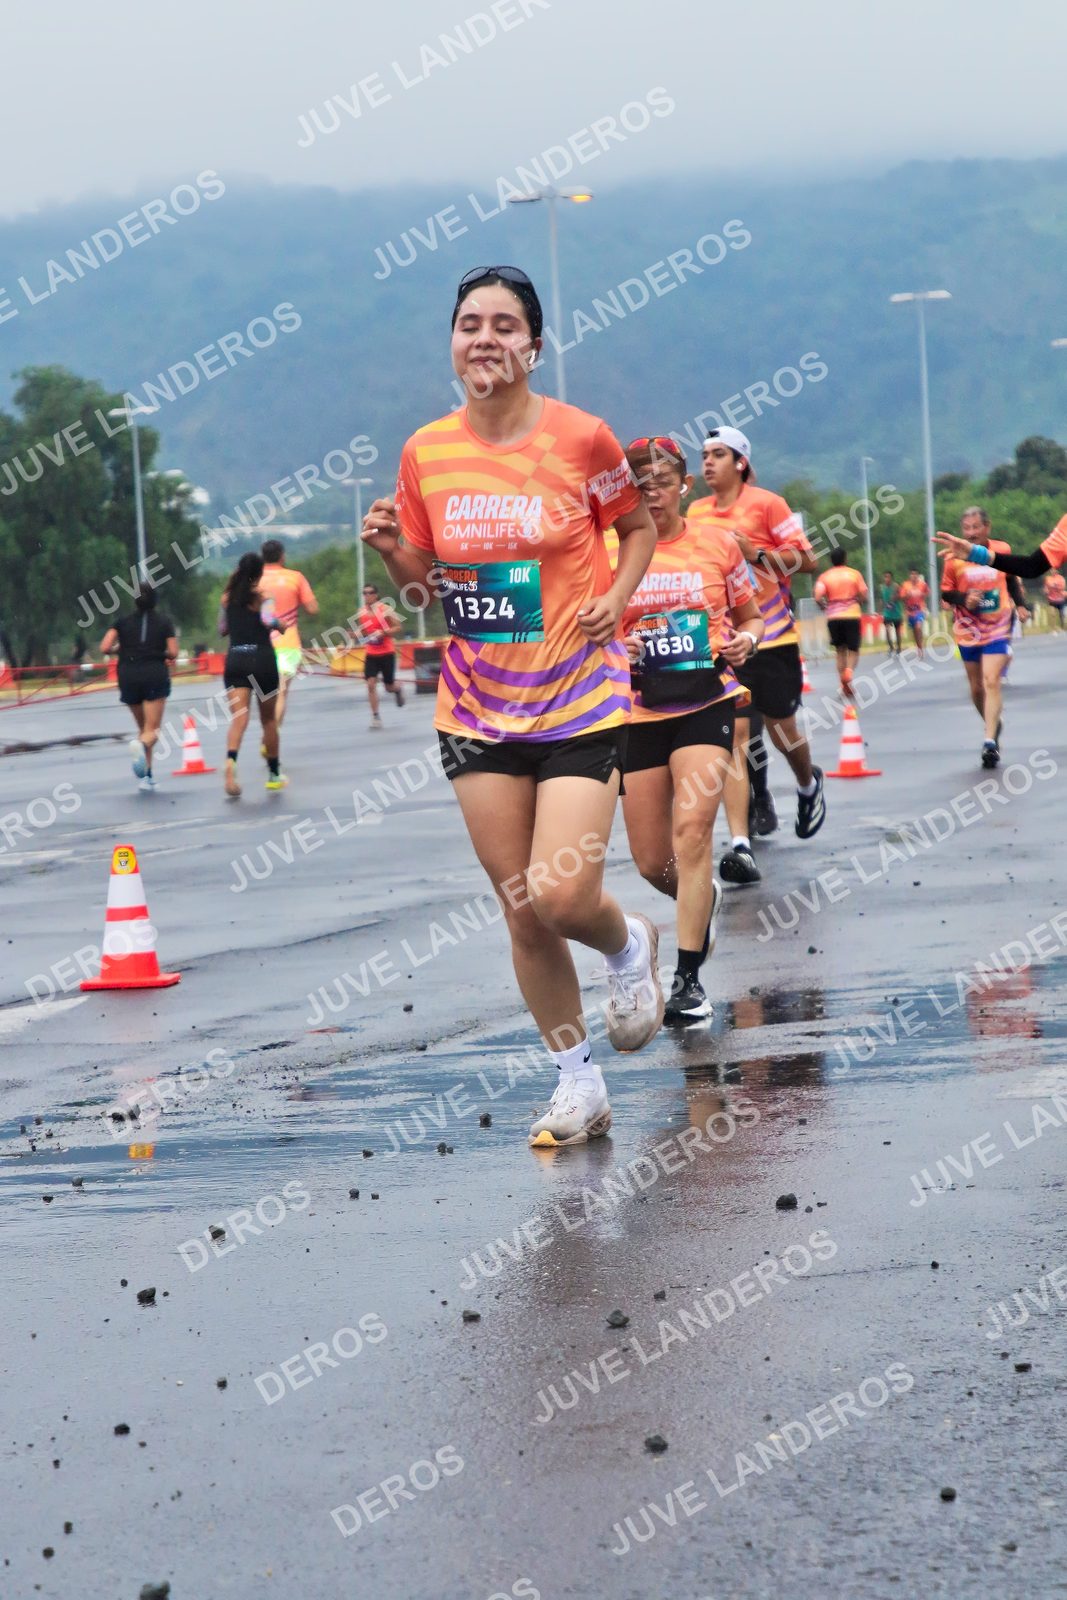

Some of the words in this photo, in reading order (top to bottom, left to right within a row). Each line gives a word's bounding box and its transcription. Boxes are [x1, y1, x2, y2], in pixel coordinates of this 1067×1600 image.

[445, 494, 543, 521] CARRERA
[443, 522, 516, 540] OMNILIFE
[441, 567, 478, 582] ARRERA
[509, 567, 531, 584] 10K
[637, 571, 704, 592] ARRERA
[454, 596, 516, 620] 1324
[686, 614, 702, 627] 10K
[645, 635, 695, 657] 1630
